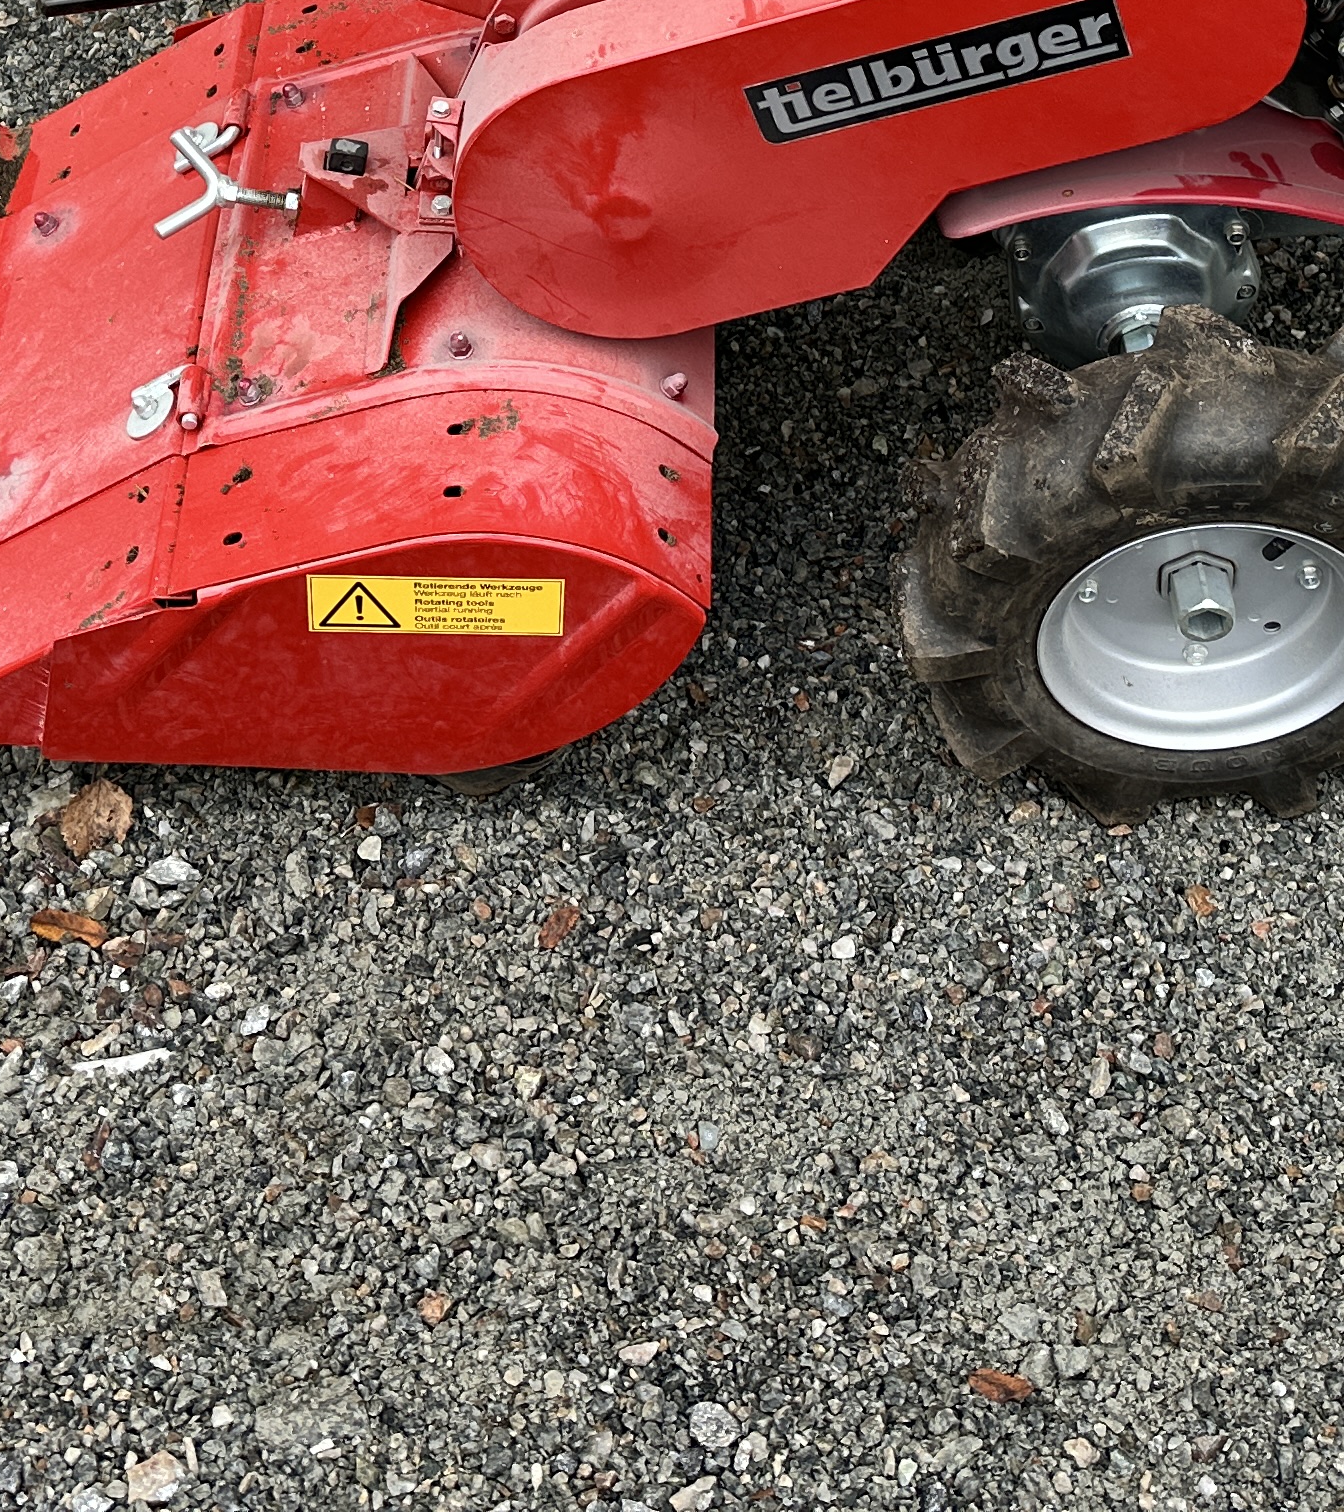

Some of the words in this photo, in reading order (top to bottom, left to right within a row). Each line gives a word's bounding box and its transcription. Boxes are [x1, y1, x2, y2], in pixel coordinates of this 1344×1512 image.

[757, 11, 1119, 134] tielbürger
[413, 582, 476, 590] Rotierende
[480, 583, 543, 592] Werkzeuge
[414, 590, 466, 598] Werkzeug
[414, 599, 463, 607] Rotating
[453, 607, 493, 615] running
